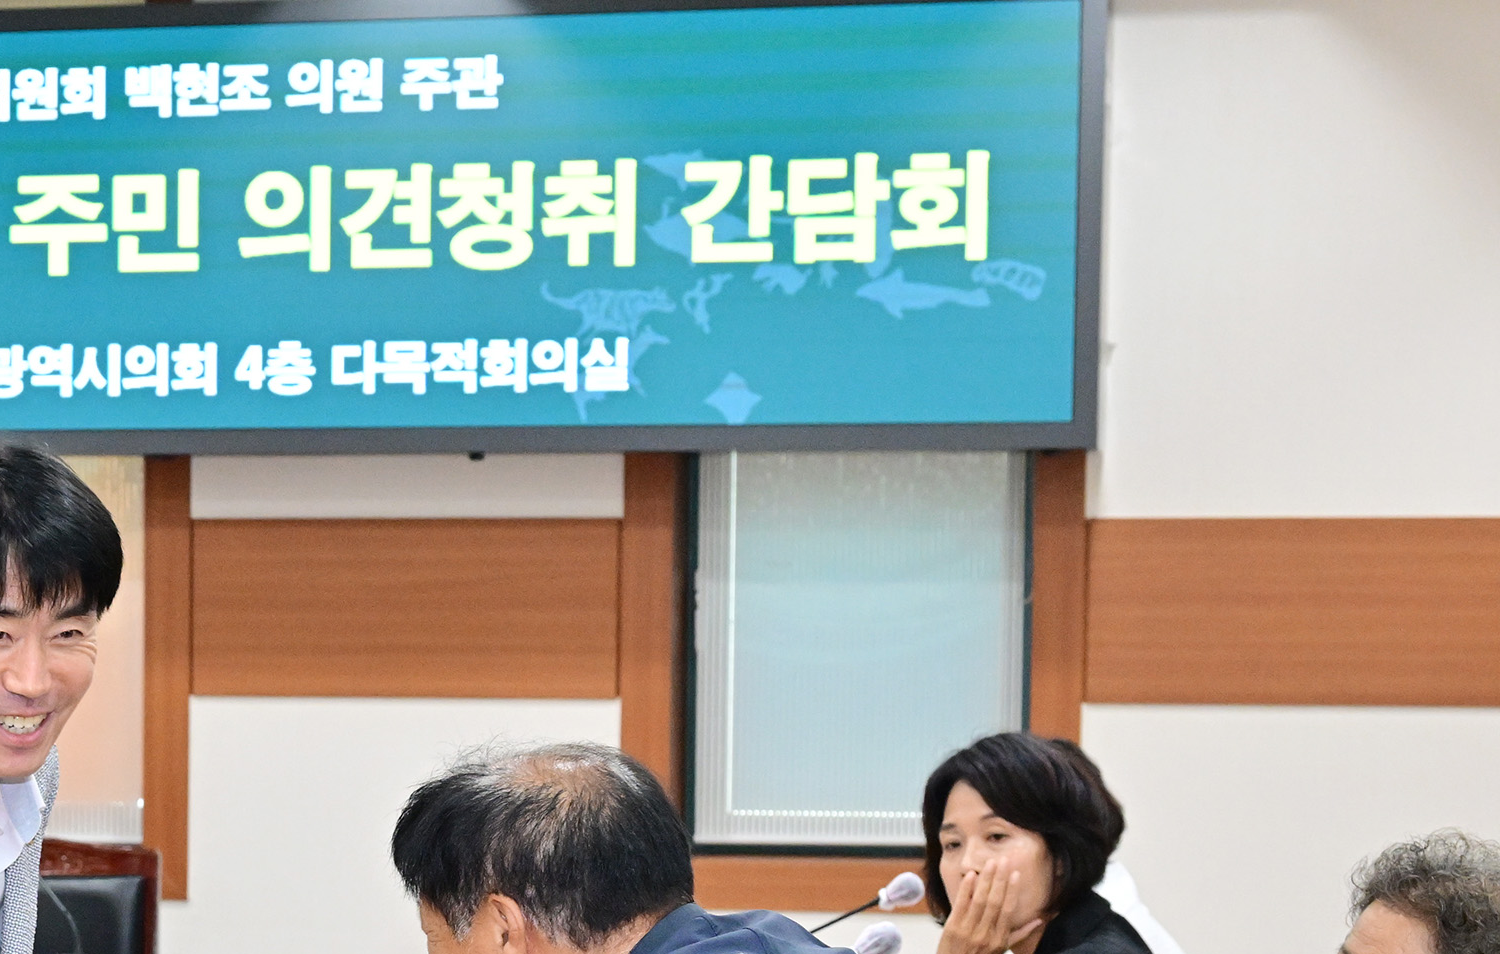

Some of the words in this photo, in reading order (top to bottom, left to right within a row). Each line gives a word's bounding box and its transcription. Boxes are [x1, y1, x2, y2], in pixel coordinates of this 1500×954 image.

[124, 62, 272, 117] 백현조
[285, 58, 384, 113] 의원
[400, 54, 504, 111] 주관
[9, 168, 200, 277] 주민
[237, 158, 638, 272] 의견청취
[681, 149, 991, 264] 간담회
[235, 341, 316, 396] 4층
[331, 337, 630, 395] 다목적회의실
